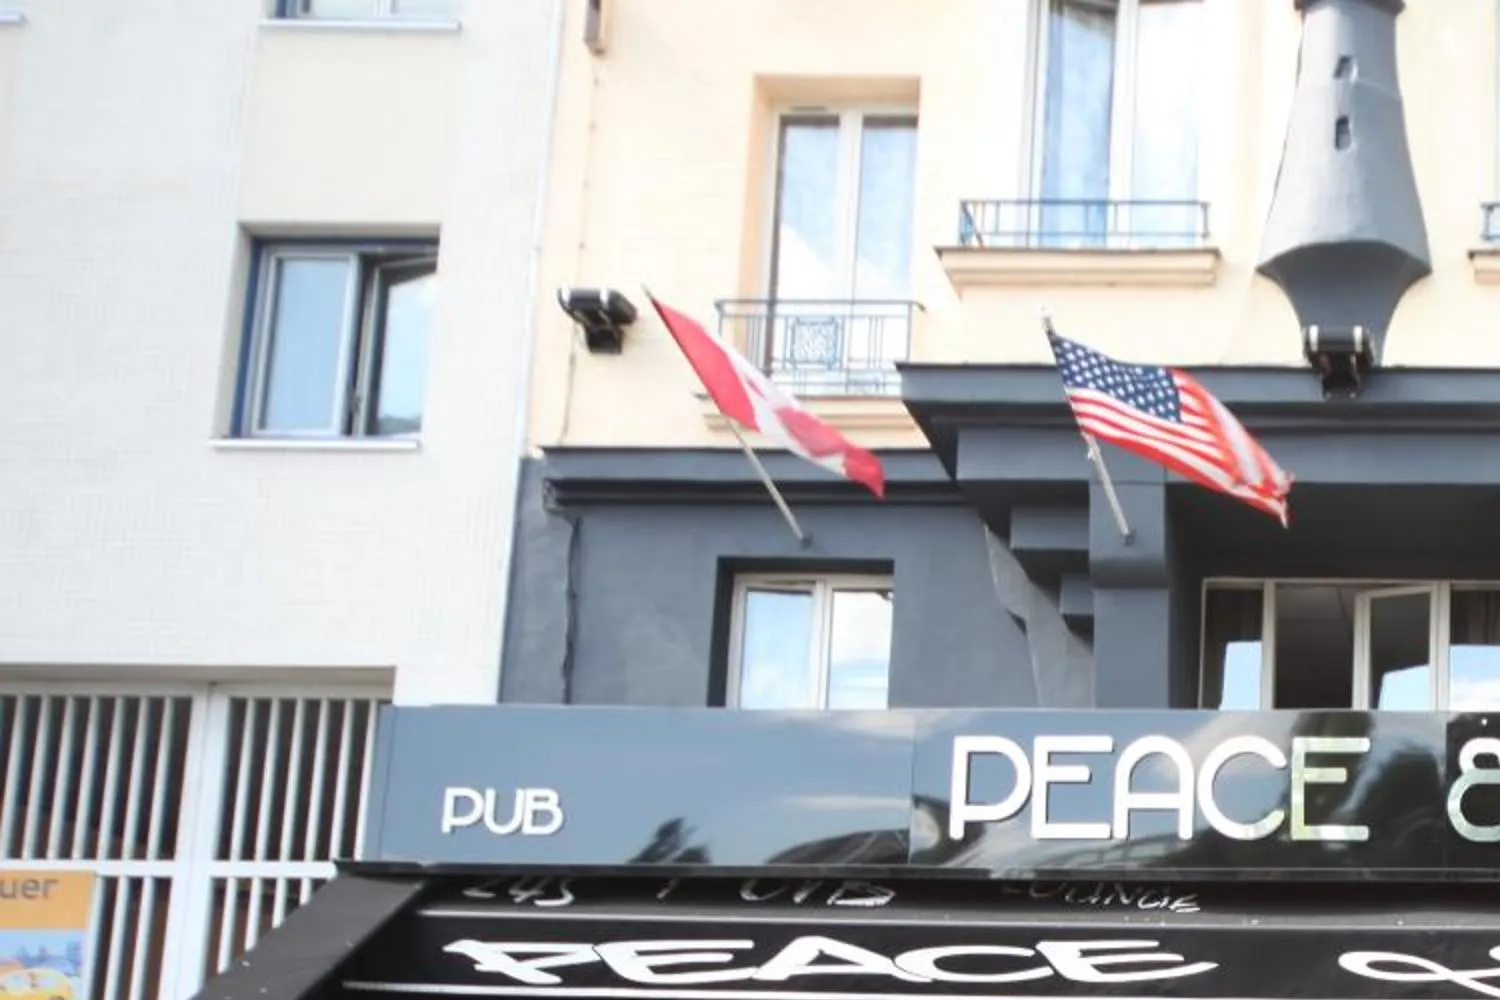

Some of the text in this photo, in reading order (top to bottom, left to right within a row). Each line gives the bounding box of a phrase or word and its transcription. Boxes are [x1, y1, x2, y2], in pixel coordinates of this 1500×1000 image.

[443, 787, 564, 836] PUB
[949, 735, 1370, 842] PEACE
[442, 935, 1220, 985] PEACE
